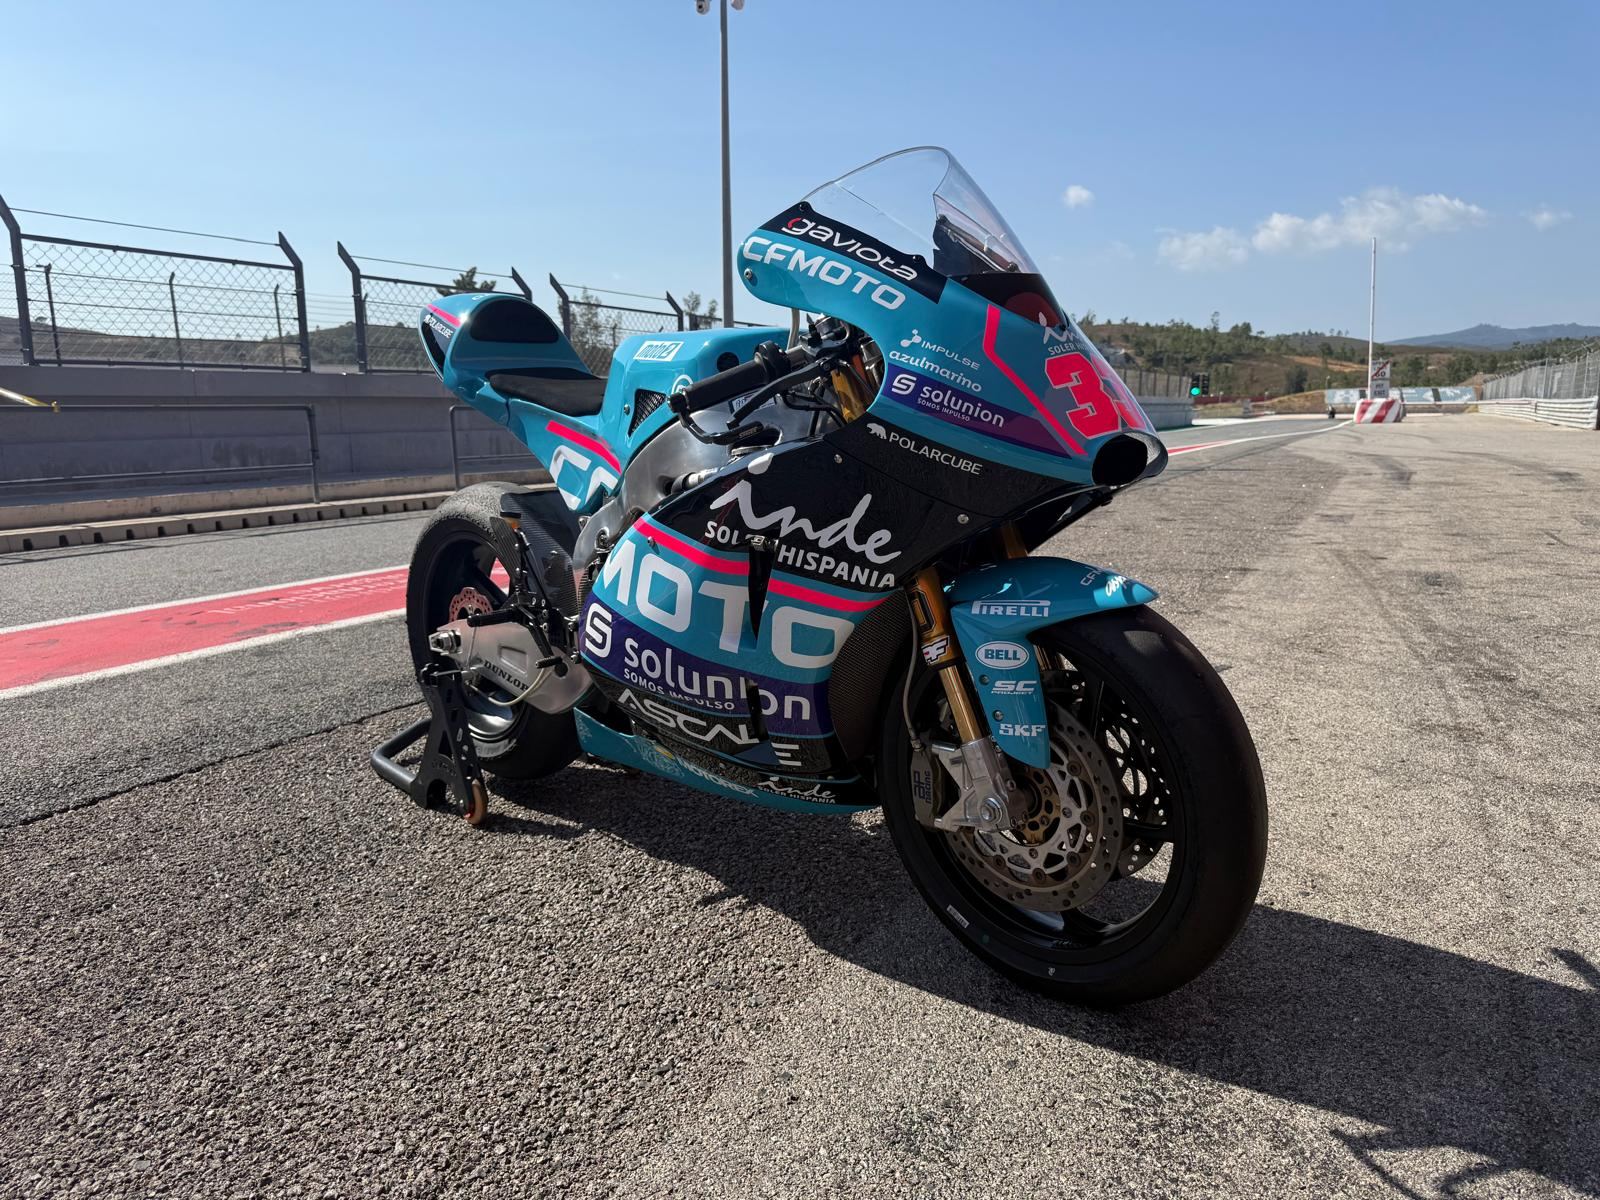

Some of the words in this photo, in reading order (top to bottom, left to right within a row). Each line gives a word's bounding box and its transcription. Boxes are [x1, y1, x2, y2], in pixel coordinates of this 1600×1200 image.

[781, 217, 918, 281] gaviota
[742, 236, 906, 310] CFMOTO
[921, 340, 981, 370] IMPULSE
[889, 350, 982, 393] azulmarino
[917, 397, 940, 411] SOMOS
[941, 407, 971, 422] IMPULSO
[919, 384, 1005, 428] solunion
[889, 431, 983, 475] POLARCUBE
[777, 544, 896, 588] HISPANIA
[971, 600, 1051, 617] PIRELLI
[984, 648, 1021, 661] BELL
[623, 667, 665, 696] SOMOS
[992, 680, 1038, 692] SC
[998, 722, 1046, 737] SKF
